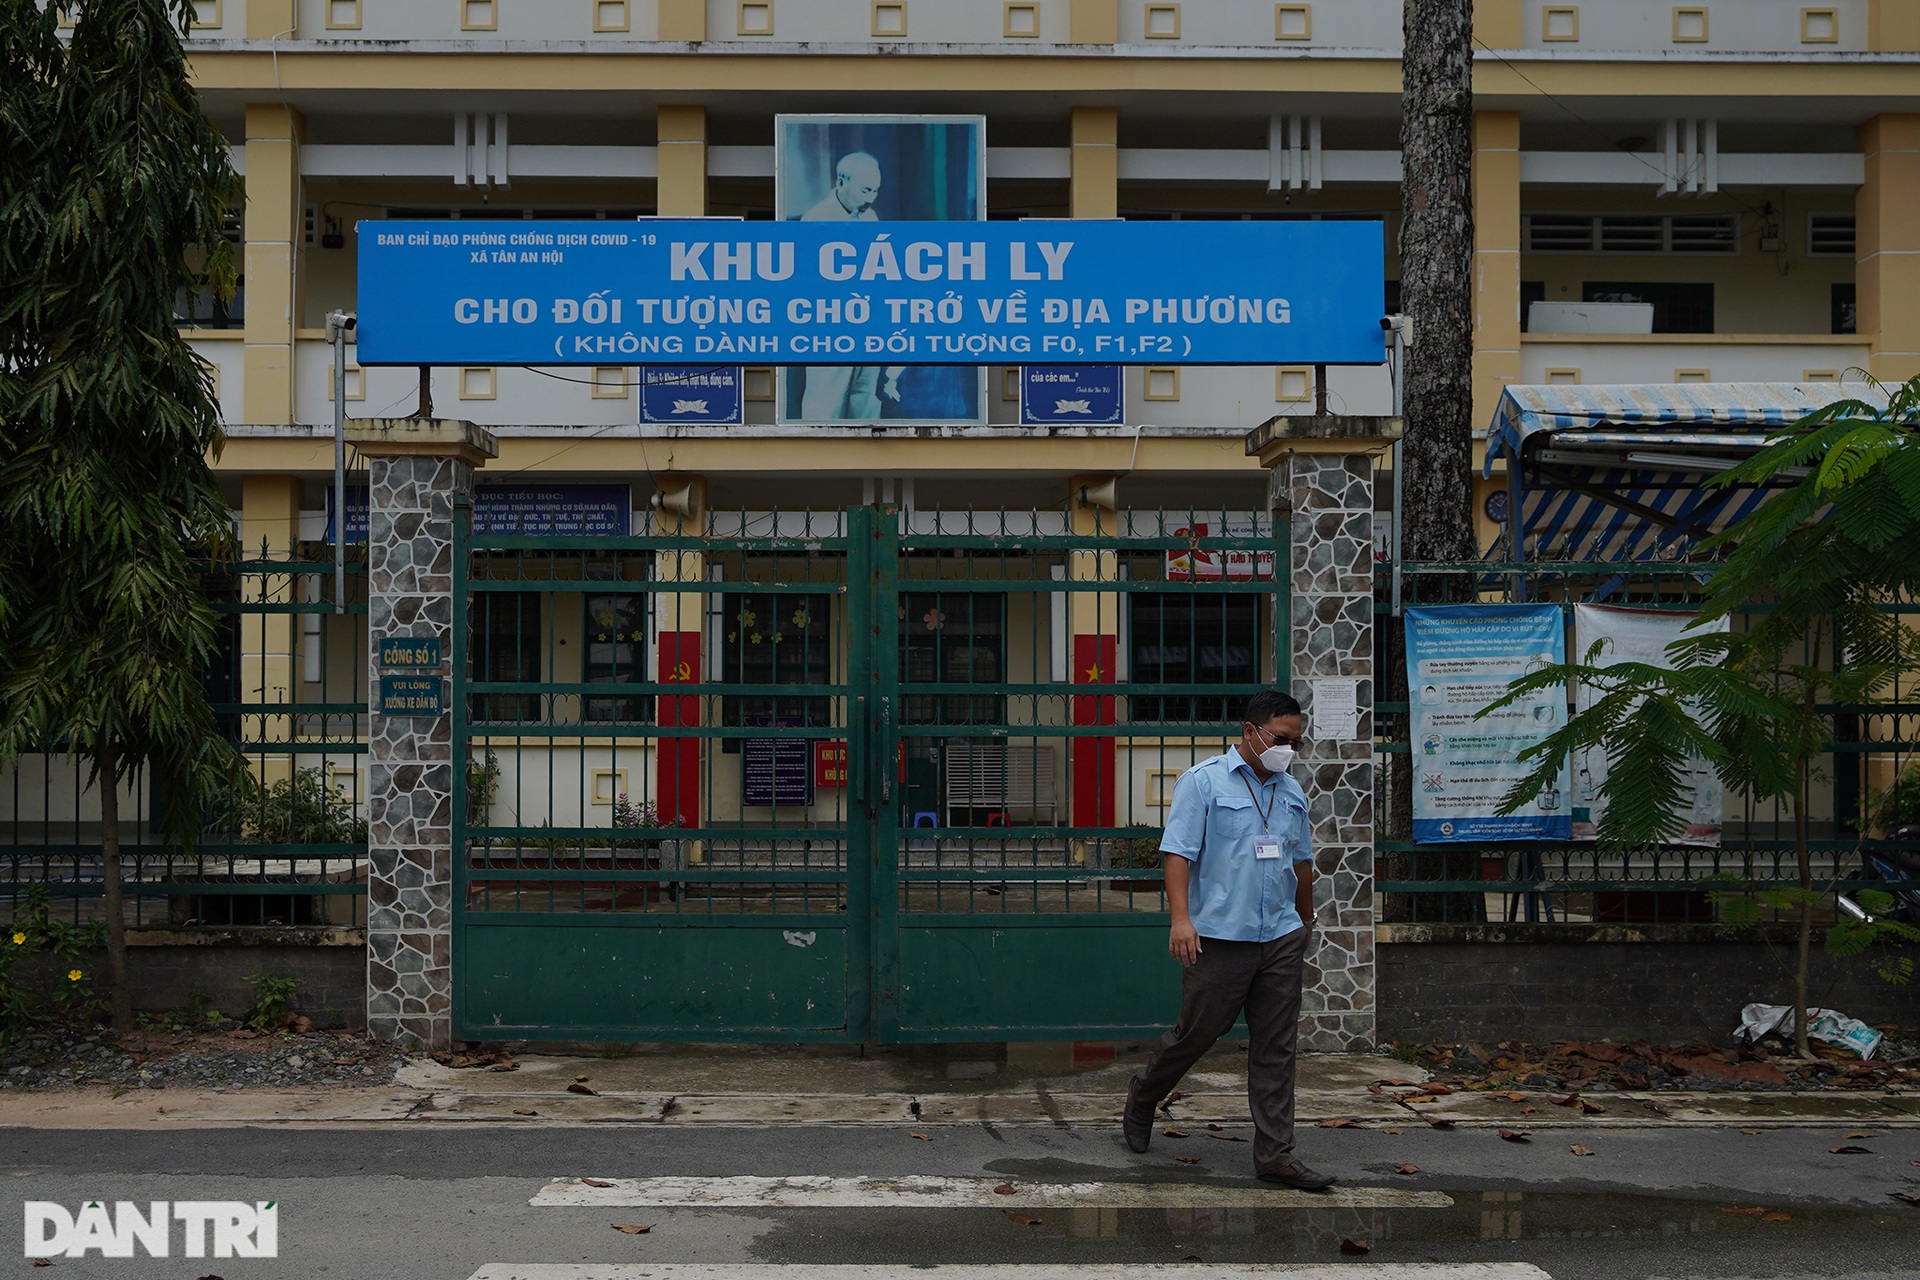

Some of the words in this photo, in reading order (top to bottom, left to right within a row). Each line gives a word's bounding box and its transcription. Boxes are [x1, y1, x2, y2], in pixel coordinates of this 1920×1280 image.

[377, 234, 404, 245] BAN
[409, 231, 430, 246] CHỈ
[433, 234, 459, 248] ĐẠO
[463, 231, 506, 246] PHÒNG
[510, 230, 554, 246] CHỐNG
[558, 234, 587, 248] DỊCH
[592, 234, 628, 246] COVID
[641, 234, 657, 246] 19
[470, 249, 488, 263] XÃ
[492, 249, 517, 263] TÂN
[520, 251, 538, 263] AN
[542, 249, 563, 265] HỘI
[670, 241, 795, 281] KHU
[818, 233, 986, 281] CÁCH
[1010, 241, 1075, 281] LY
[454, 298, 538, 324] CHO
[552, 290, 622, 324] ĐỐI
[637, 295, 771, 329] TƯỢNG
[787, 293, 871, 324] CHỜ
[885, 291, 963, 324] TRỞ
[977, 290, 1027, 324] VỀ
[1041, 298, 1111, 329] ĐỊA
[1125, 295, 1291, 324] PHƯƠNG
[575, 331, 683, 353] KHÔNG
[695, 331, 779, 353] DÀNH
[789, 335, 856, 353] CHO
[864, 328, 915, 353] ĐỐI
[925, 333, 1031, 357] TƯỢNG
[1043, 335, 1084, 356] F0,
[1030, 370, 1044, 383] của
[1045, 372, 1058, 383] các
[481, 492, 505, 501] DỤC
[508, 490, 534, 500] TIỂU
[537, 493, 564, 501] HỌC:
[384, 641, 413, 664] CỔNG
[415, 642, 429, 664] SỐ
[432, 649, 437, 664] 1
[392, 681, 406, 690] VUI
[408, 679, 431, 690] LÒNG
[384, 692, 406, 709] XUỐNG
[407, 697, 415, 709] XE
[822, 749, 834, 761] KHU
[825, 767, 845, 781] KHÔG
